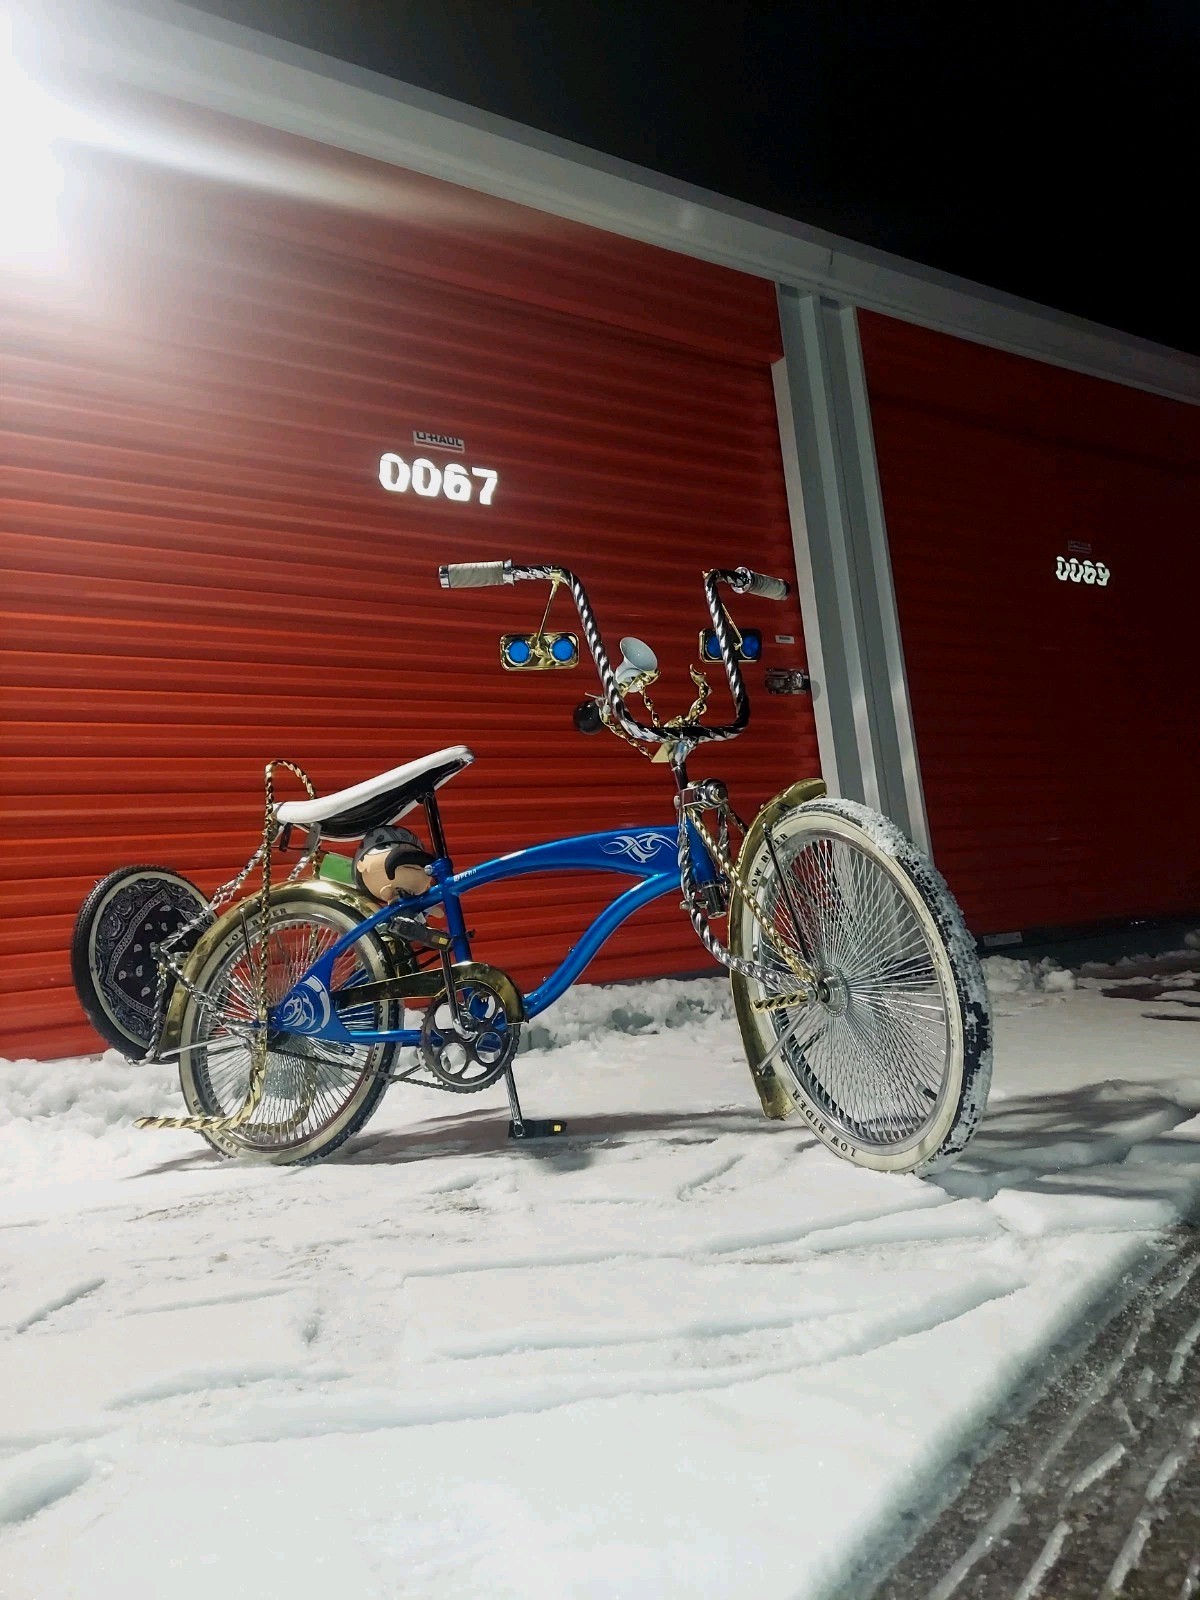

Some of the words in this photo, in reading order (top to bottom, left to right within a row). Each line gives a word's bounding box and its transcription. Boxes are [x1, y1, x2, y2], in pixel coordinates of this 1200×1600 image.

[416, 431, 463, 447] U-HAUL
[379, 453, 498, 505] 0067
[792, 1089, 827, 1134] RIDER
[831, 1135, 857, 1157] LOW
